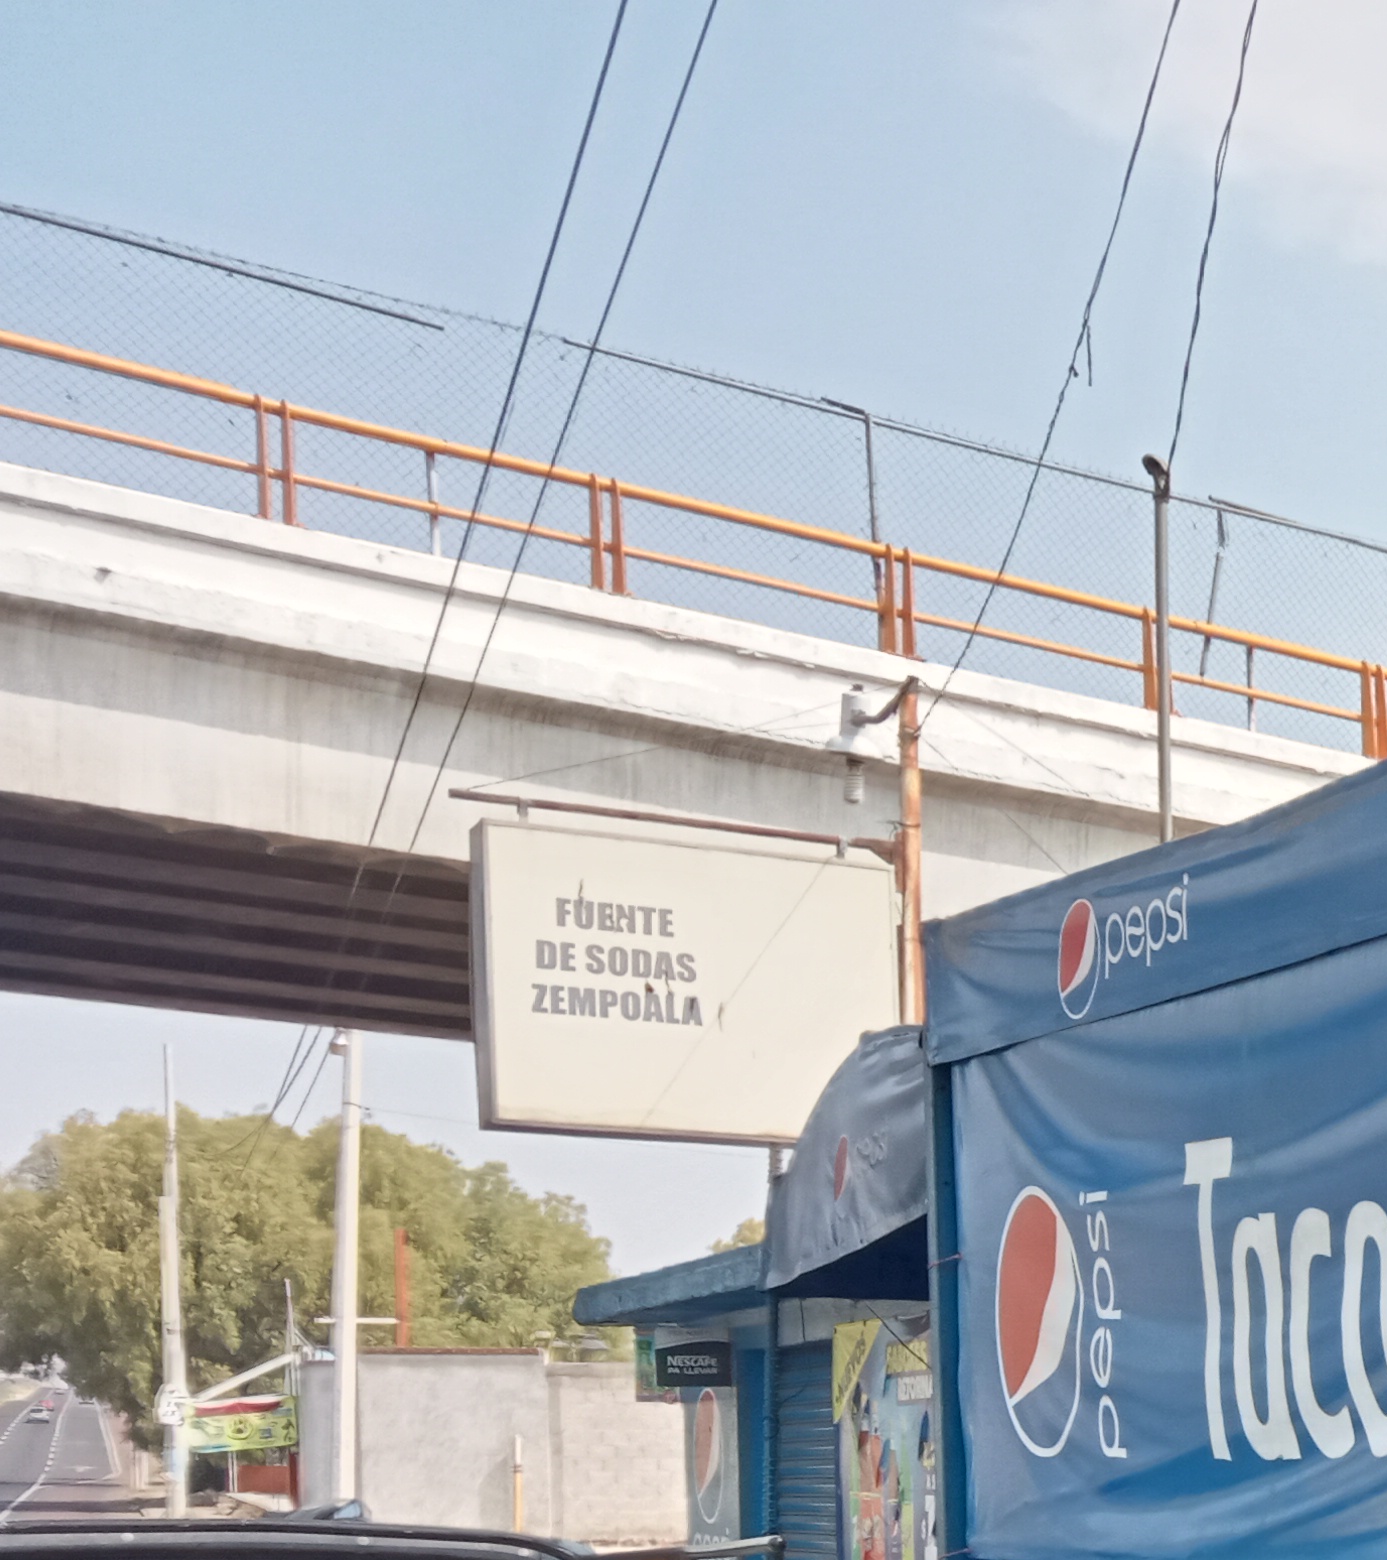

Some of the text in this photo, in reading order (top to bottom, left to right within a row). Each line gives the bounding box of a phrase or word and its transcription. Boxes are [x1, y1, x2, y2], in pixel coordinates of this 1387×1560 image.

[555, 897, 674, 938] FUENTE
[1104, 872, 1190, 979] pepsi
[535, 939, 698, 984] DE SODAS
[531, 983, 704, 1027] ZEMPOALA
[1078, 1189, 1128, 1459] pepsi
